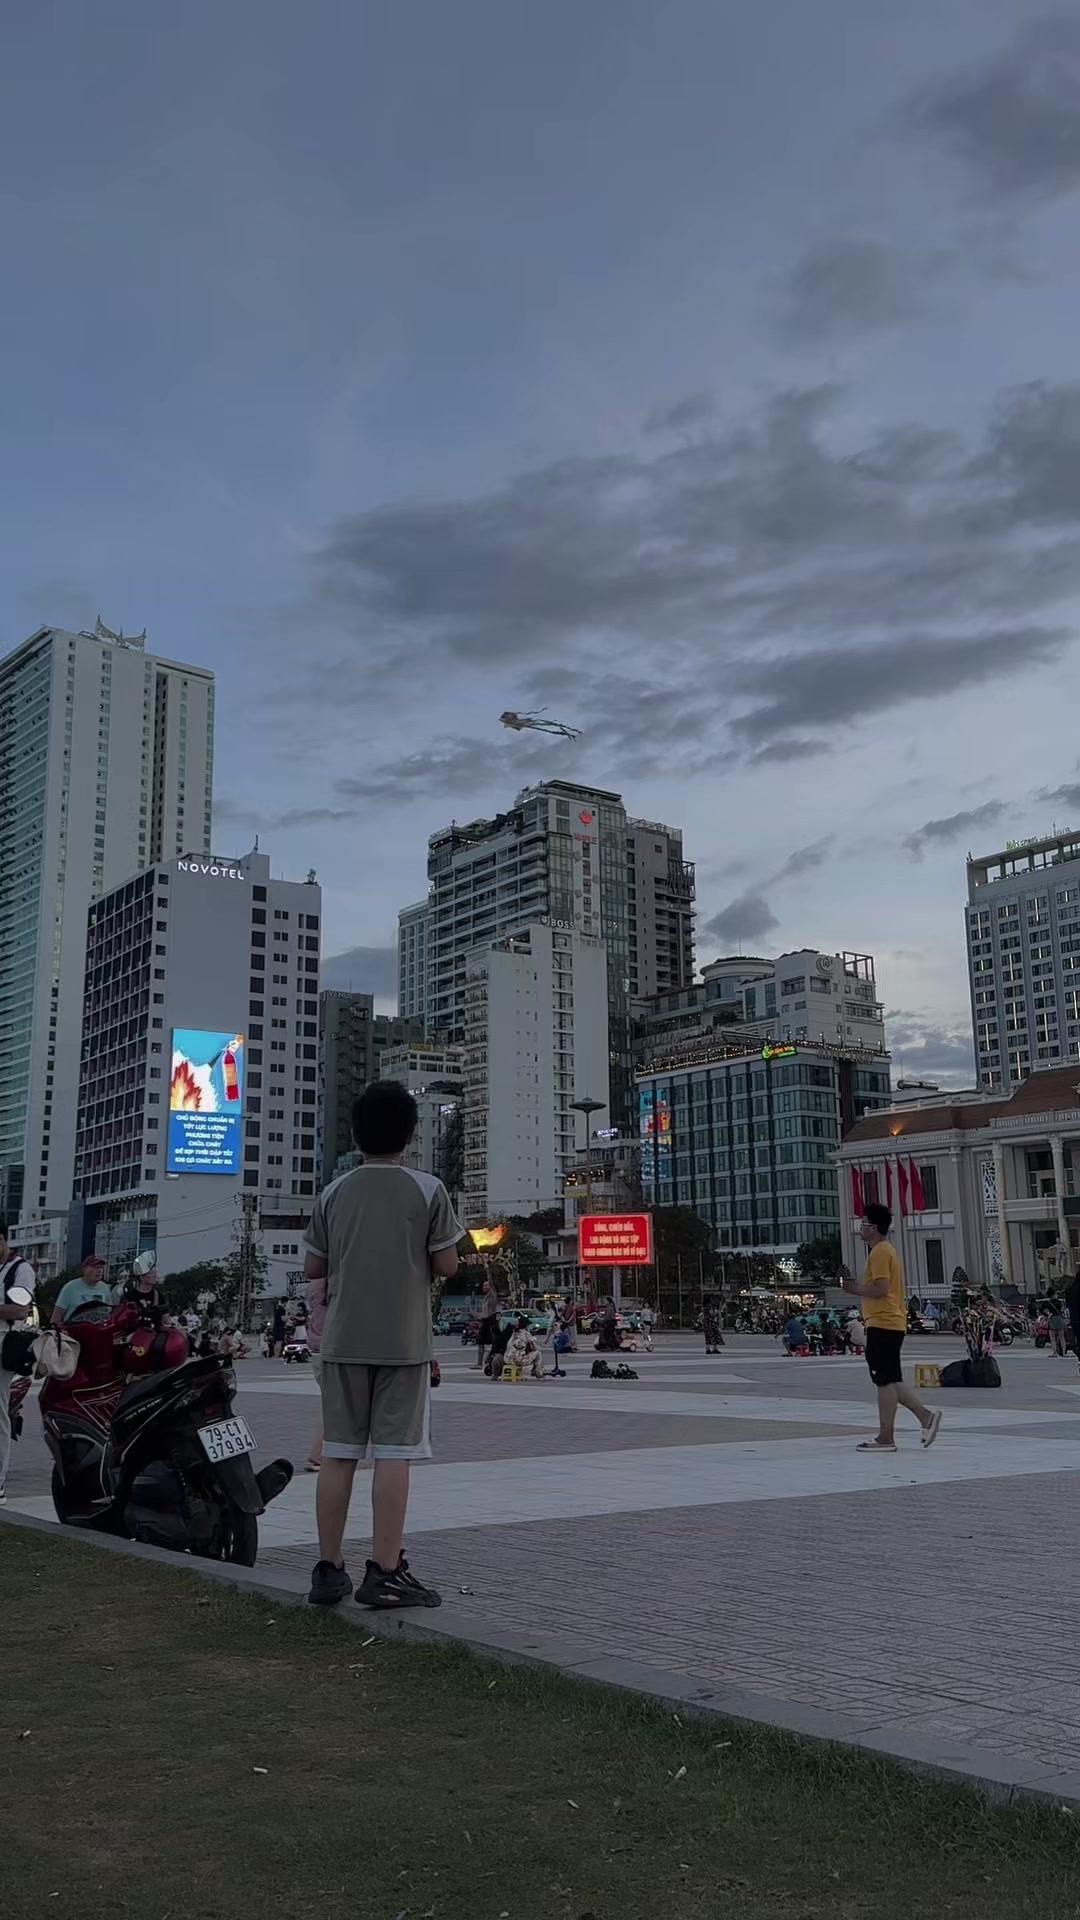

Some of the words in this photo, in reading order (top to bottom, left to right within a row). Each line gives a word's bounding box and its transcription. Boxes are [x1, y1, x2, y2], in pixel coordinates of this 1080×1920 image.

[178, 861, 245, 880] NOVOTEL
[206, 1421, 241, 1443] 79-C1
[208, 1434, 253, 1459] 379.94
